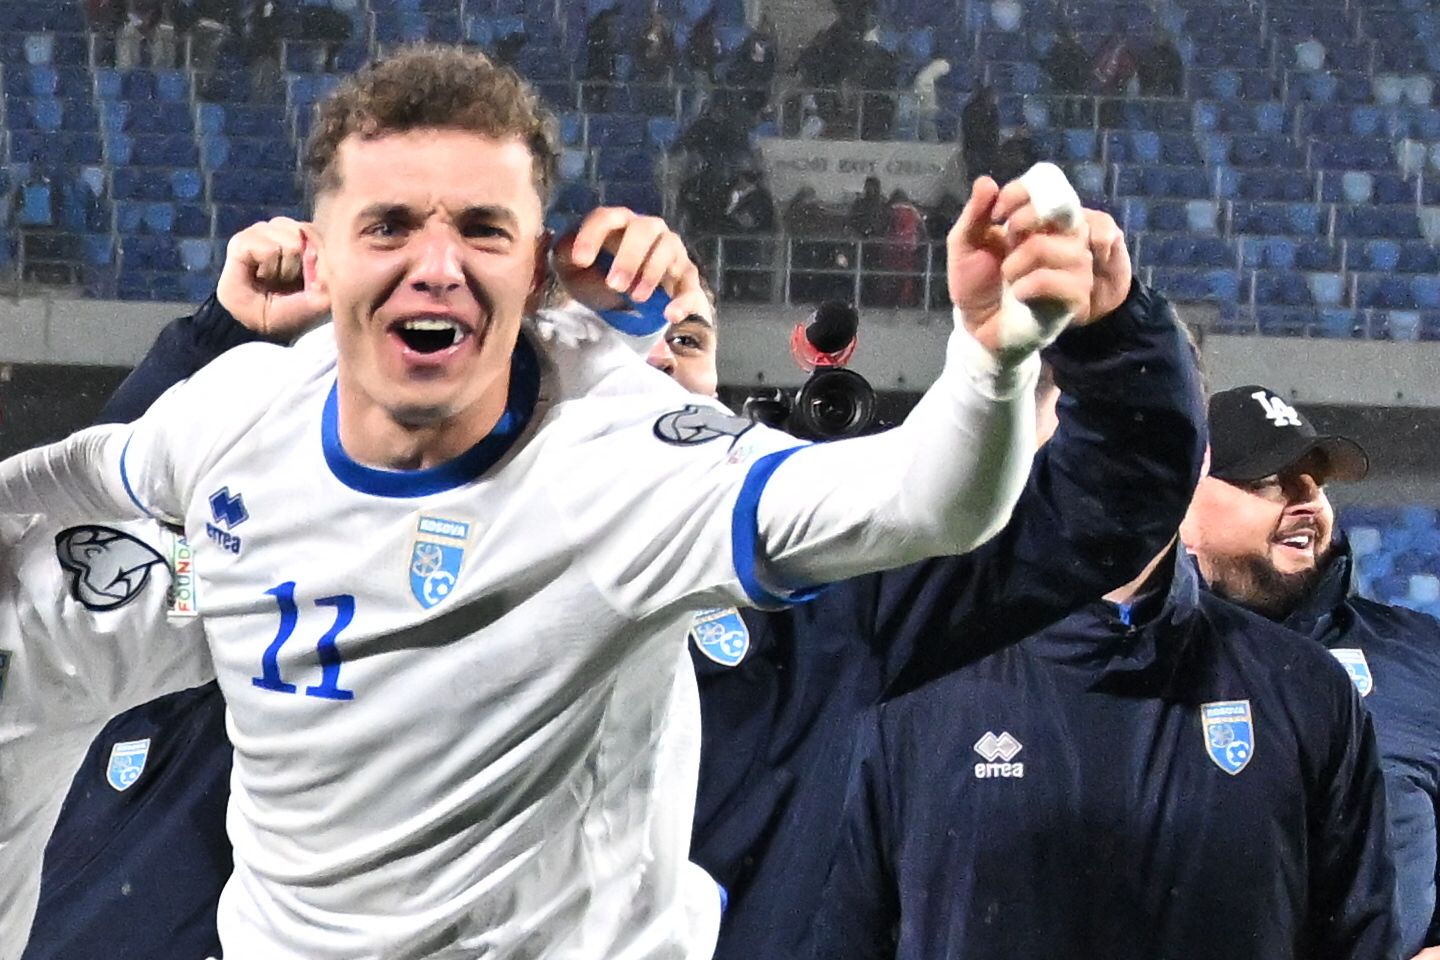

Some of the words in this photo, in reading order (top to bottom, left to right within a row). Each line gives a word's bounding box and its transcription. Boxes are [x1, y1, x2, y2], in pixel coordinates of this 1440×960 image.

[1250, 391, 1302, 427] LA
[205, 522, 241, 555] errea
[176, 536, 191, 612] FOUNDA
[251, 581, 356, 701] 11
[974, 762, 1025, 779] errea
